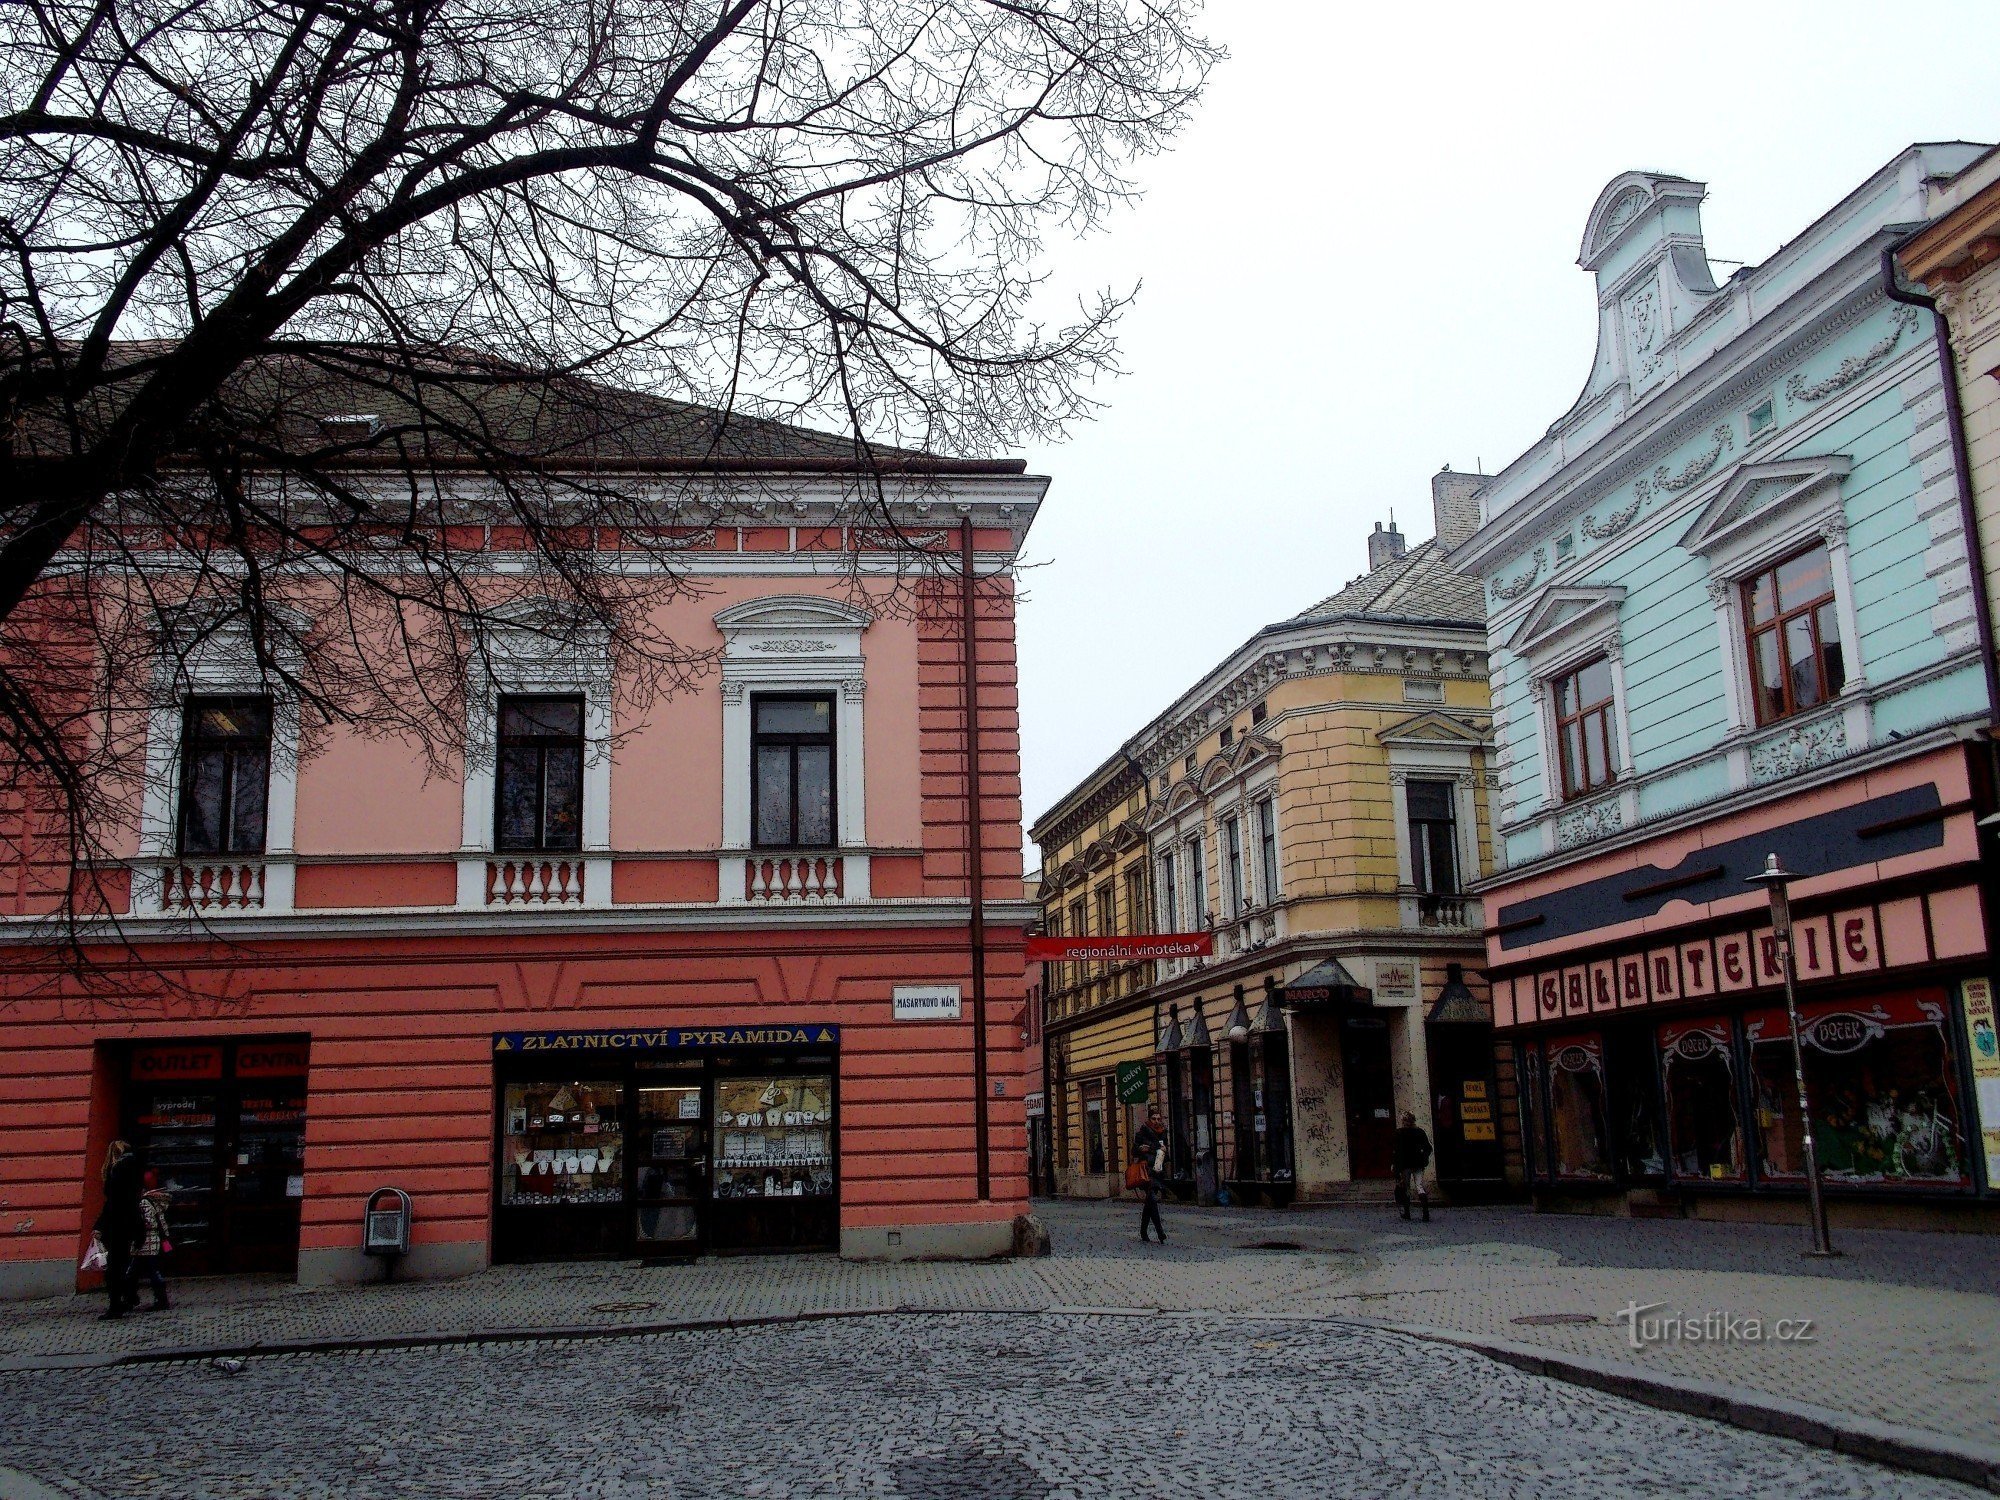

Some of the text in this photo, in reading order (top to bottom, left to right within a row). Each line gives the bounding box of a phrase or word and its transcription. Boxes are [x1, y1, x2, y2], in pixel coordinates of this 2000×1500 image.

[1066, 943, 1192, 960] regionální vinotéka
[1542, 917, 1868, 1013] GALANTERIE
[897, 996, 957, 1008] MASARYKOVO NÁM.
[522, 1029, 809, 1050] ZLATNICTVÍ PYRAMIDA
[1818, 1021, 1862, 1042] BOČEK
[140, 1054, 212, 1071] OUTLET
[1121, 1065, 1142, 1084] ODĚVY
[1122, 1079, 1144, 1098] TEXTIL
